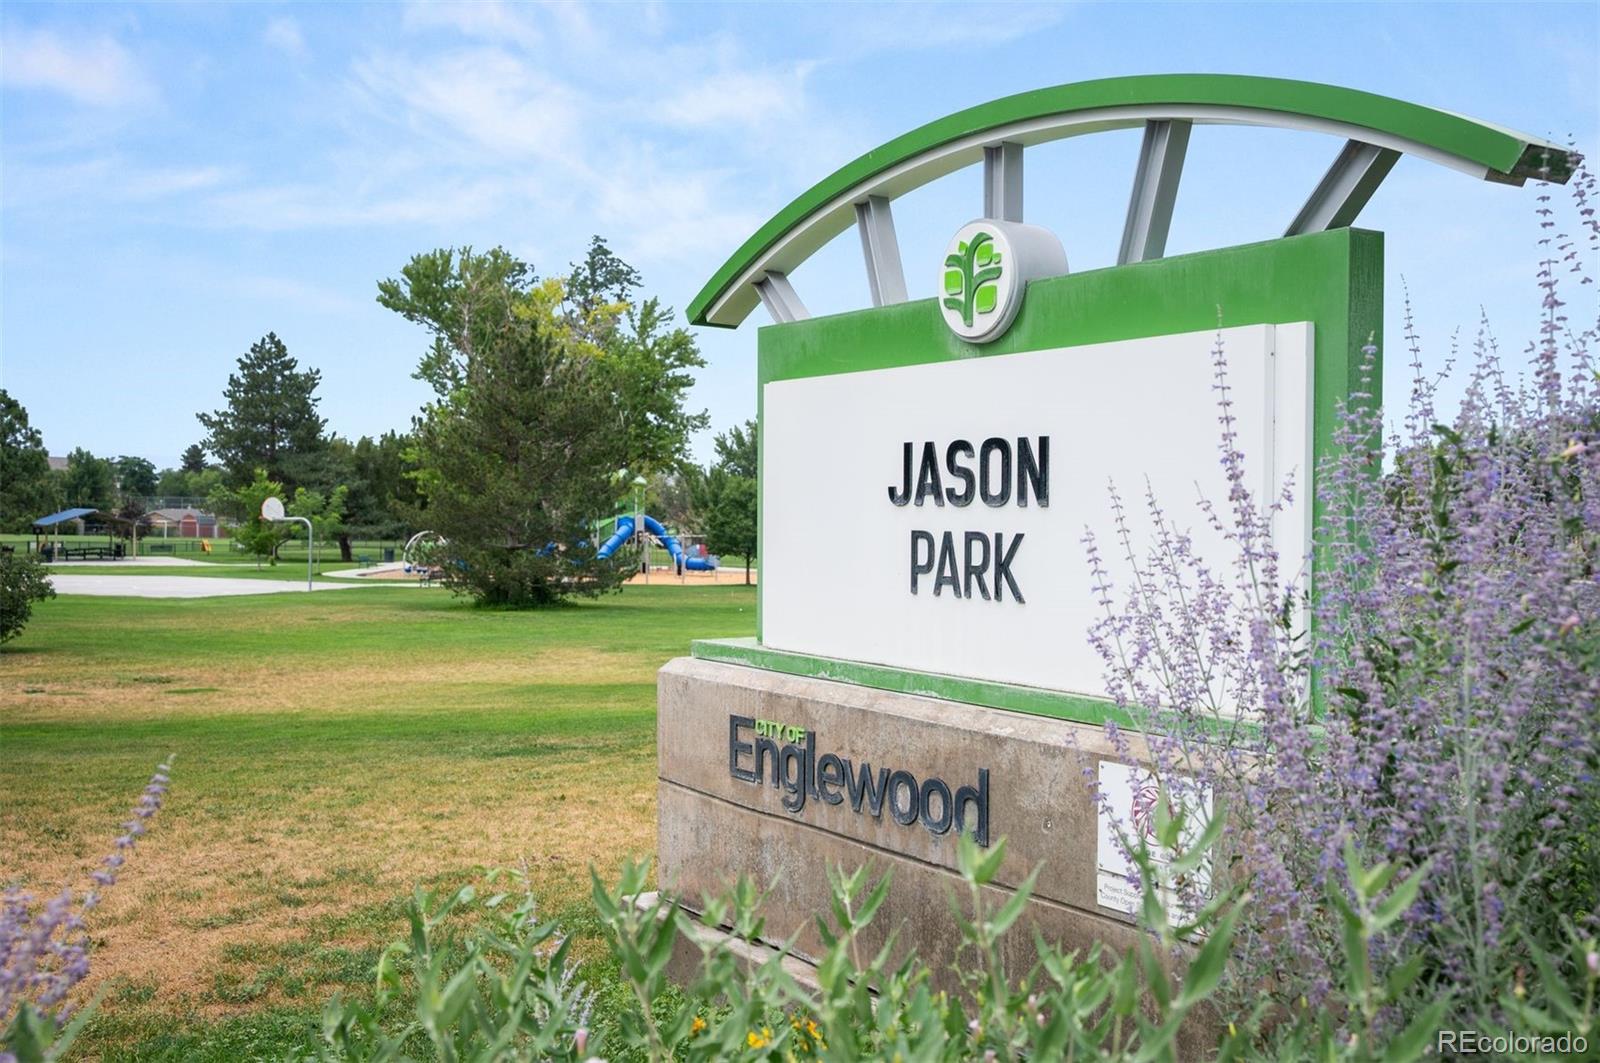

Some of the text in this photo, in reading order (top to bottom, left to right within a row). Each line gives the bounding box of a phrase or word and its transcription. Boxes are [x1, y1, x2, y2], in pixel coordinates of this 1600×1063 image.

[887, 435, 1050, 508] JASON
[910, 529, 1026, 604] PARK
[755, 719, 806, 744] CITY OF
[729, 714, 990, 847] Englewood
